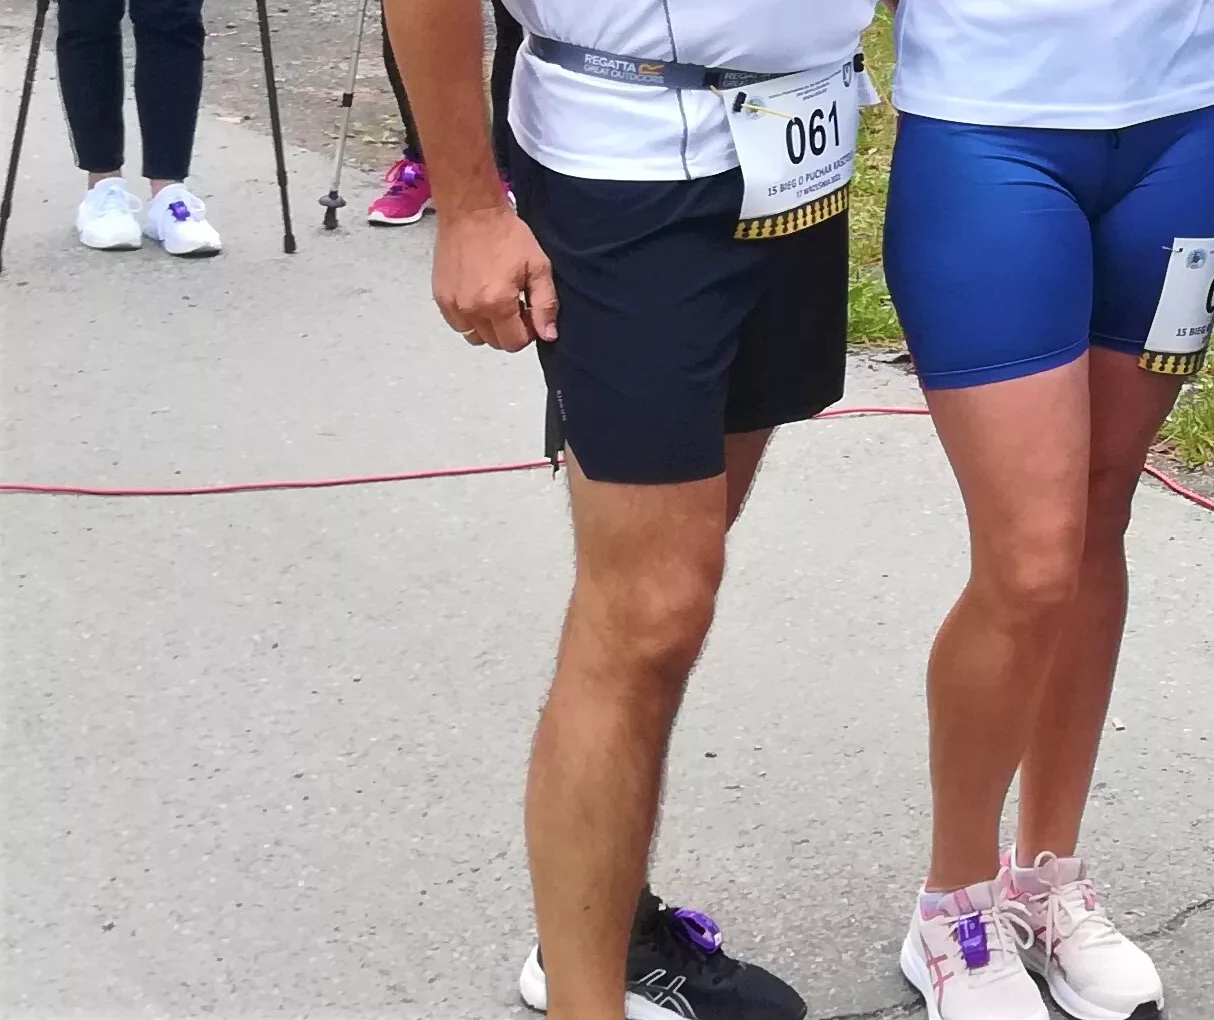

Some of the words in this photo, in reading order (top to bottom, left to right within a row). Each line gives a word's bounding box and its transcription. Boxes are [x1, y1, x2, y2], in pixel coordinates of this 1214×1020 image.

[584, 53, 637, 73] REGATTA
[785, 100, 840, 165] 061
[768, 185, 777, 197] 15
[779, 178, 797, 193] BIEG
[798, 175, 803, 186] O
[1175, 327, 1187, 337] 15
